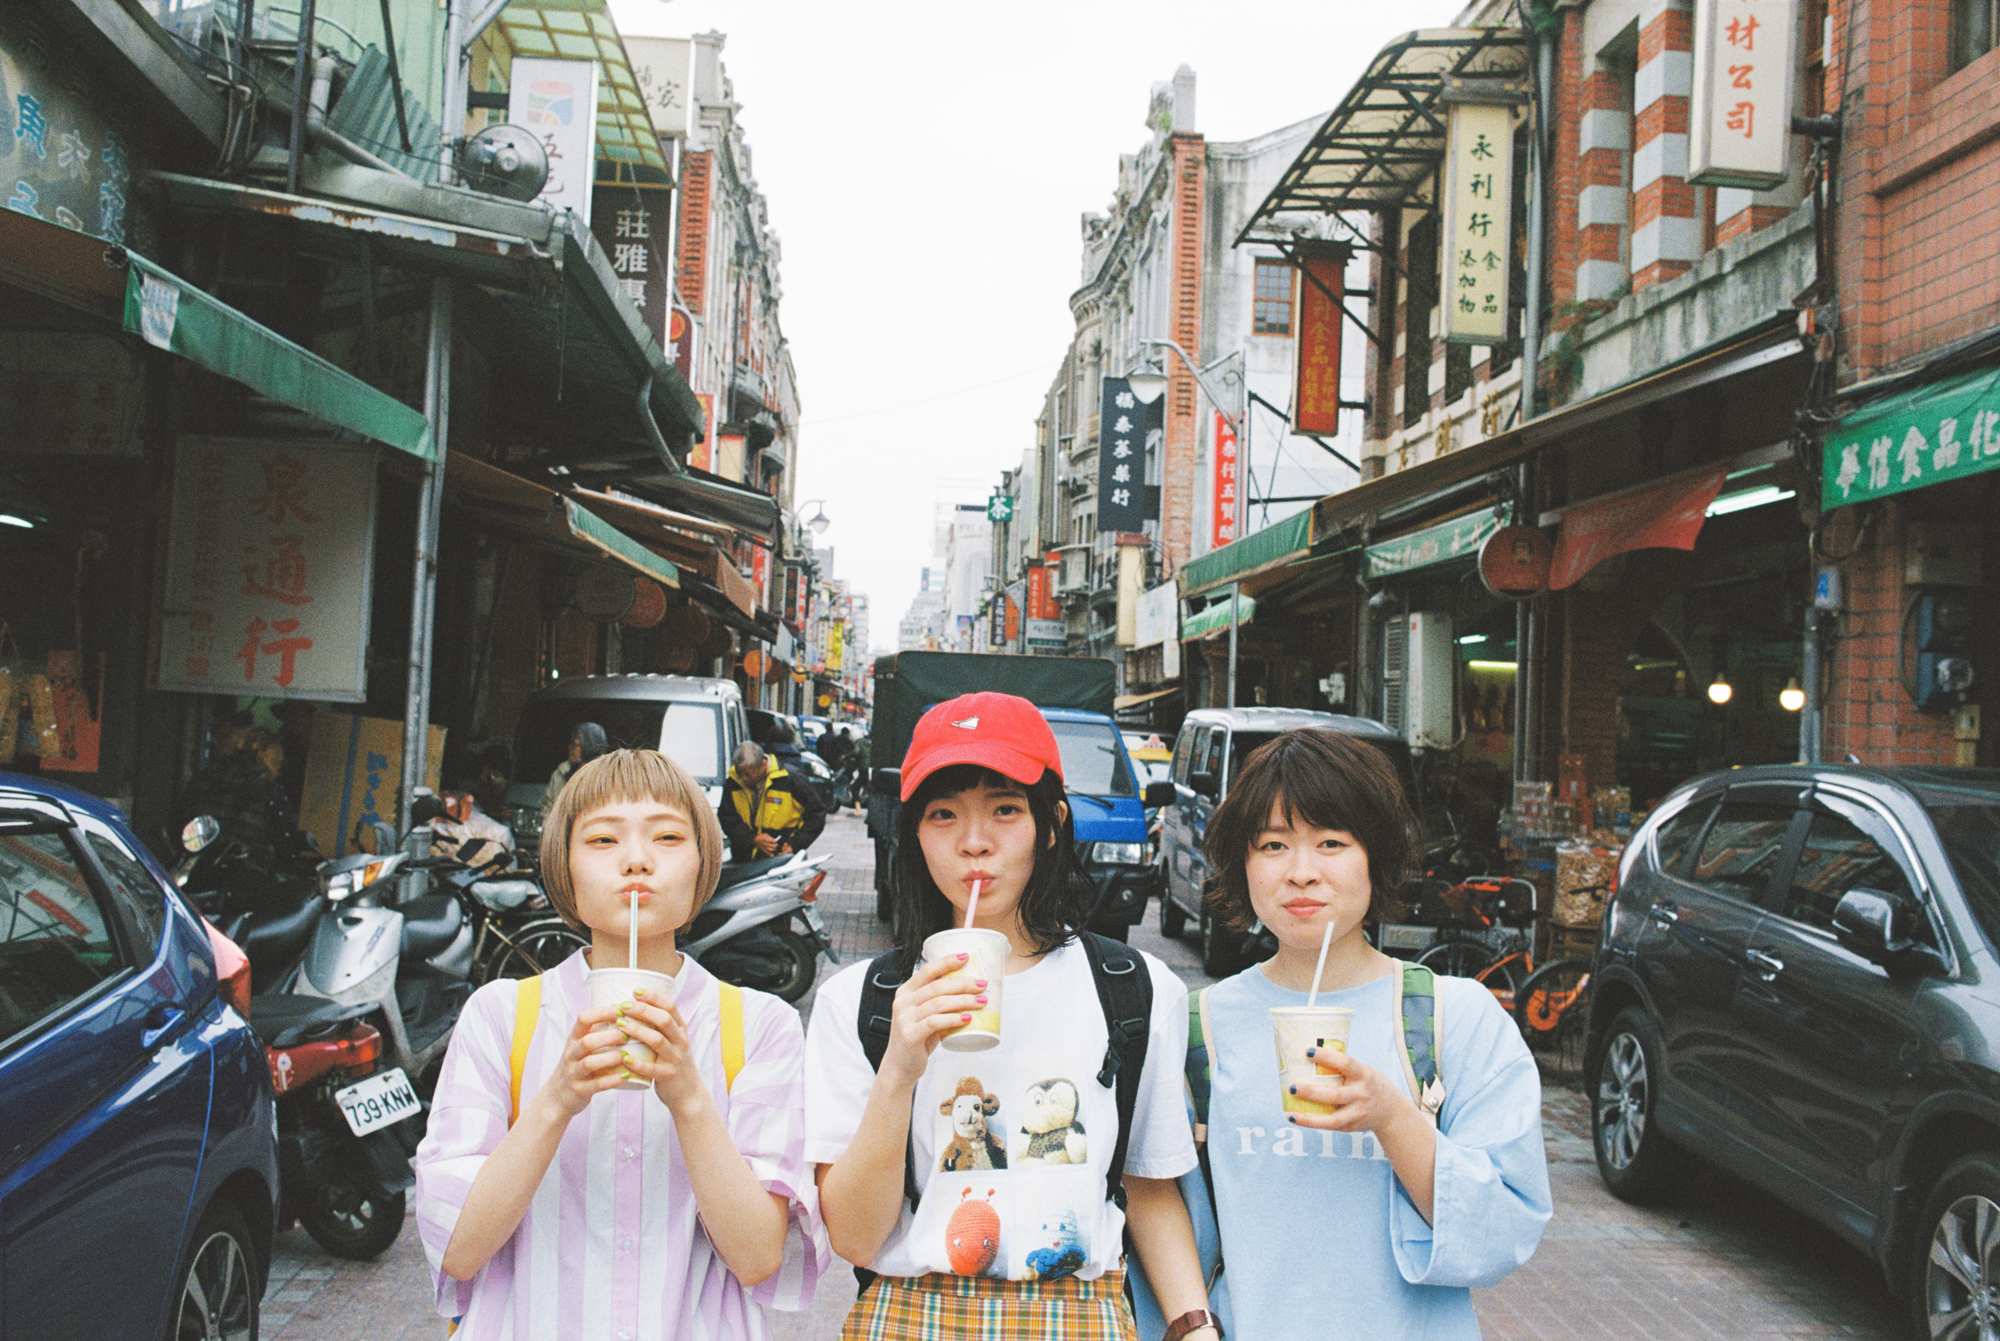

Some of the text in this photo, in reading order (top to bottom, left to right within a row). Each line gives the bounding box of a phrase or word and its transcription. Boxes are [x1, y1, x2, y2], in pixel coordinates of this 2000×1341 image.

[1724, 0, 1761, 139] 材公司
[1468, 134, 1495, 238] 永利行
[989, 496, 1011, 519] 茶
[236, 451, 321, 688] 泉通行
